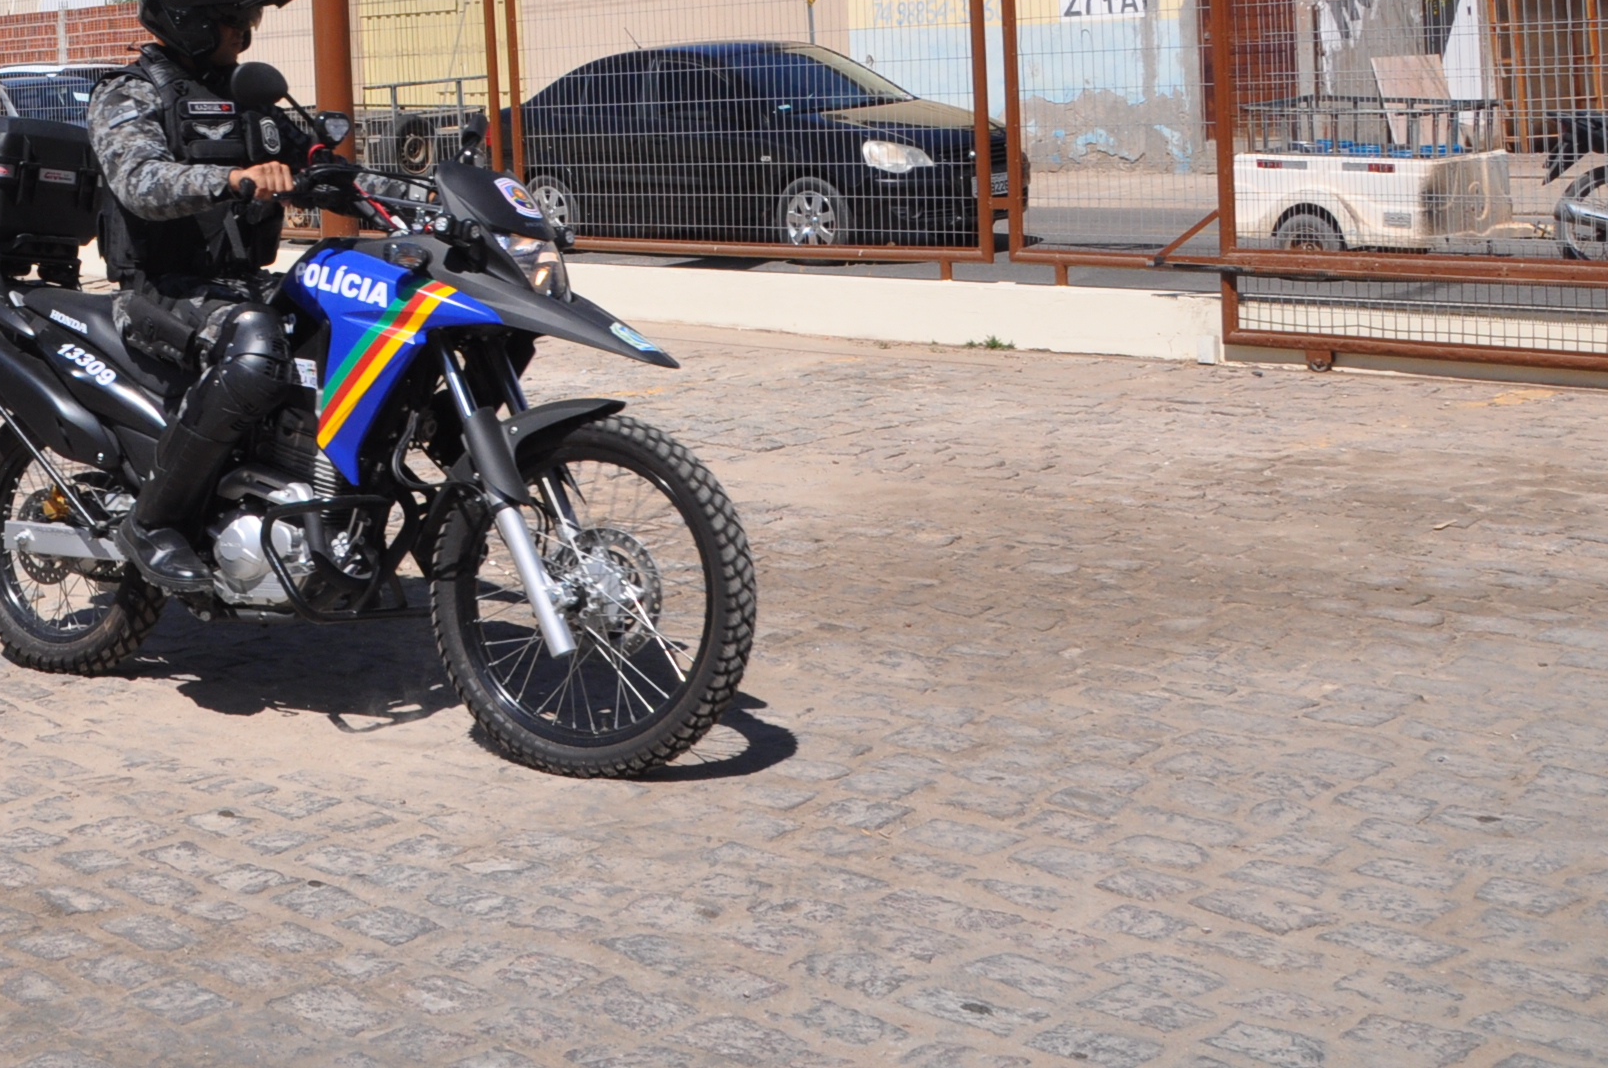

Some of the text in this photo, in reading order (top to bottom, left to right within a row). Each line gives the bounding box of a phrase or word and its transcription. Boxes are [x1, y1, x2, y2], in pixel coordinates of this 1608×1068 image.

[295, 262, 388, 308] POLÍCIA
[50, 309, 88, 334] HONDA
[57, 343, 117, 386] 13309
